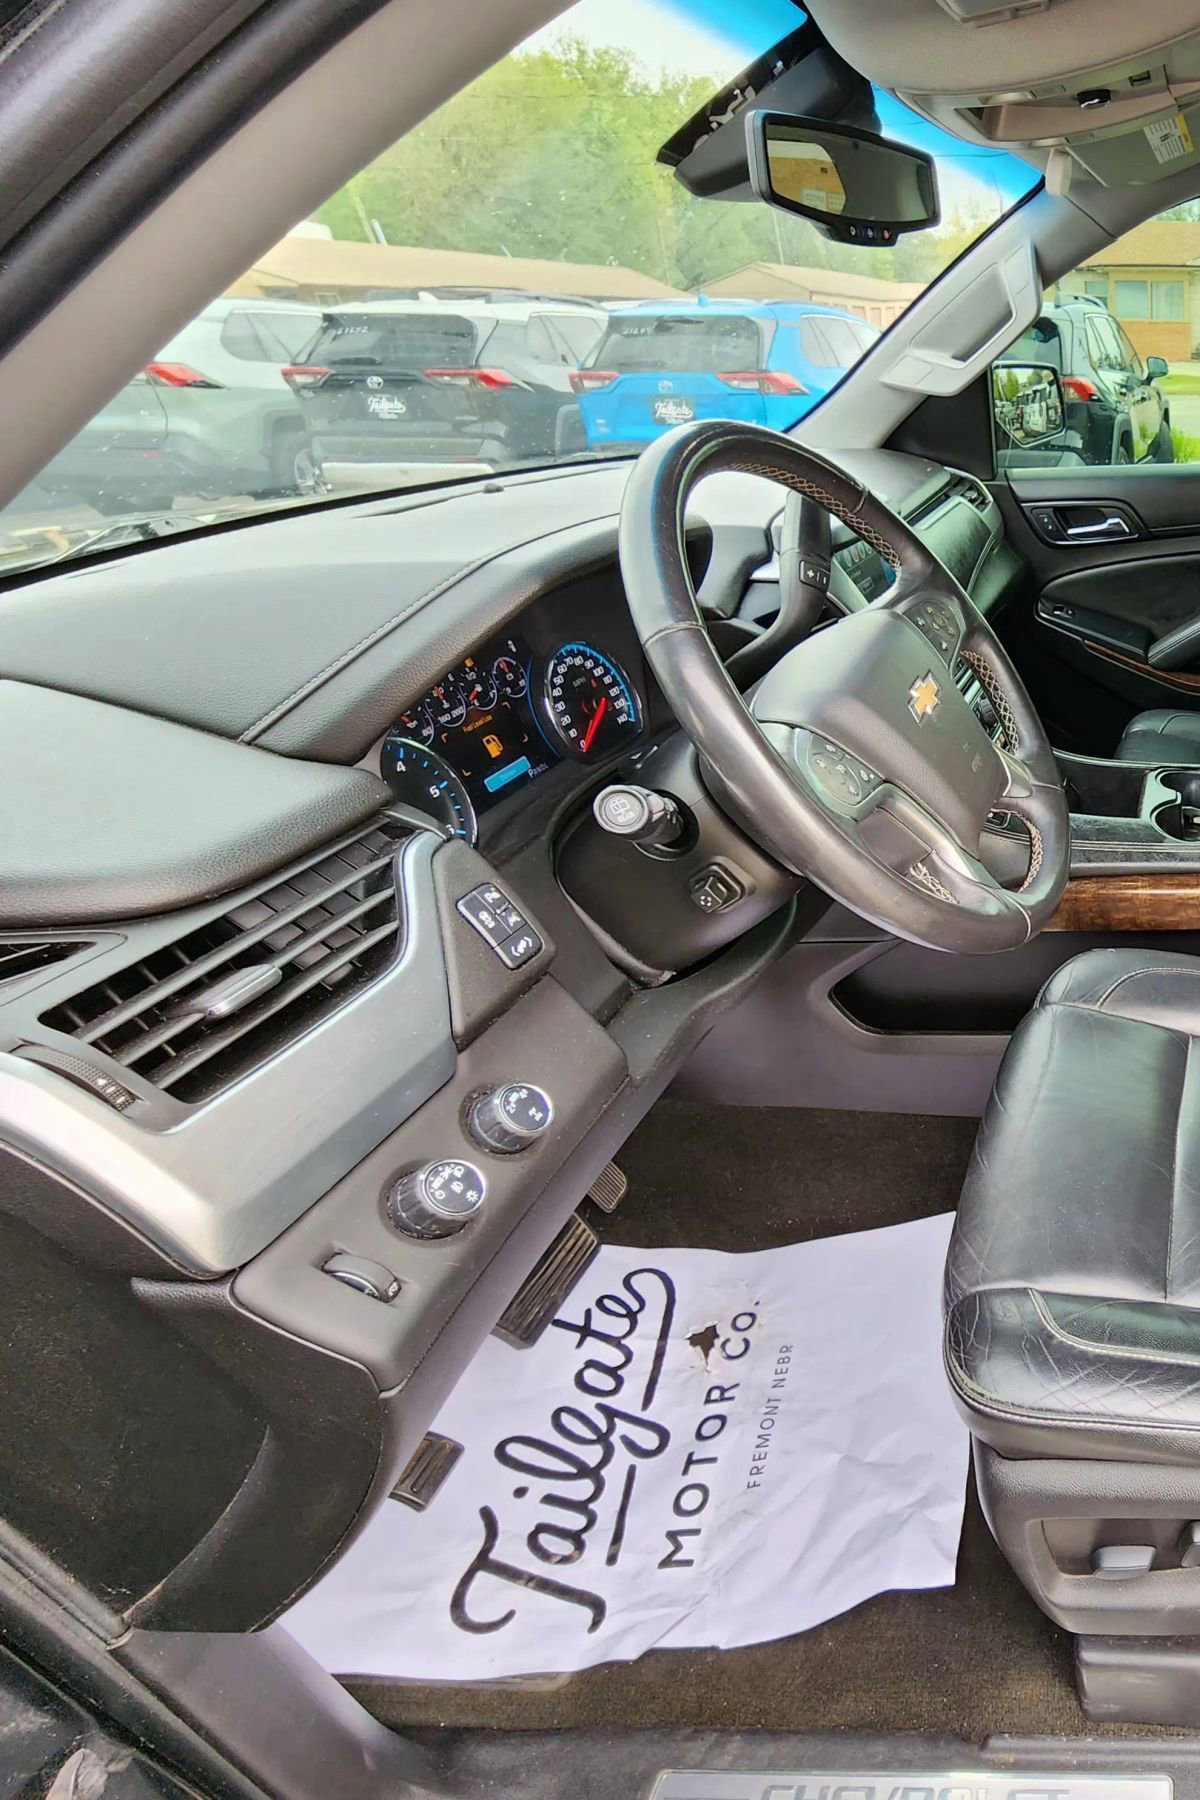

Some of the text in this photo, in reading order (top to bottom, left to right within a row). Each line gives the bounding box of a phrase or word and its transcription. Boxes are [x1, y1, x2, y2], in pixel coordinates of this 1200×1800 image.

[563, 656, 574, 667] 70
[574, 655, 584, 666] 80
[584, 659, 595, 669] 90
[557, 664, 568, 674] 60
[553, 675, 565, 686] 50
[552, 687, 563, 697] 40
[554, 701, 566, 712] 30
[560, 714, 571, 726] 20
[396, 761, 406, 773] 4
[429, 785, 440, 798] 5
[746, 1344, 794, 1490] FREMONT NEBR
[657, 1300, 760, 1569] MOTOR CO.
[449, 1267, 676, 1635] Tailgate
